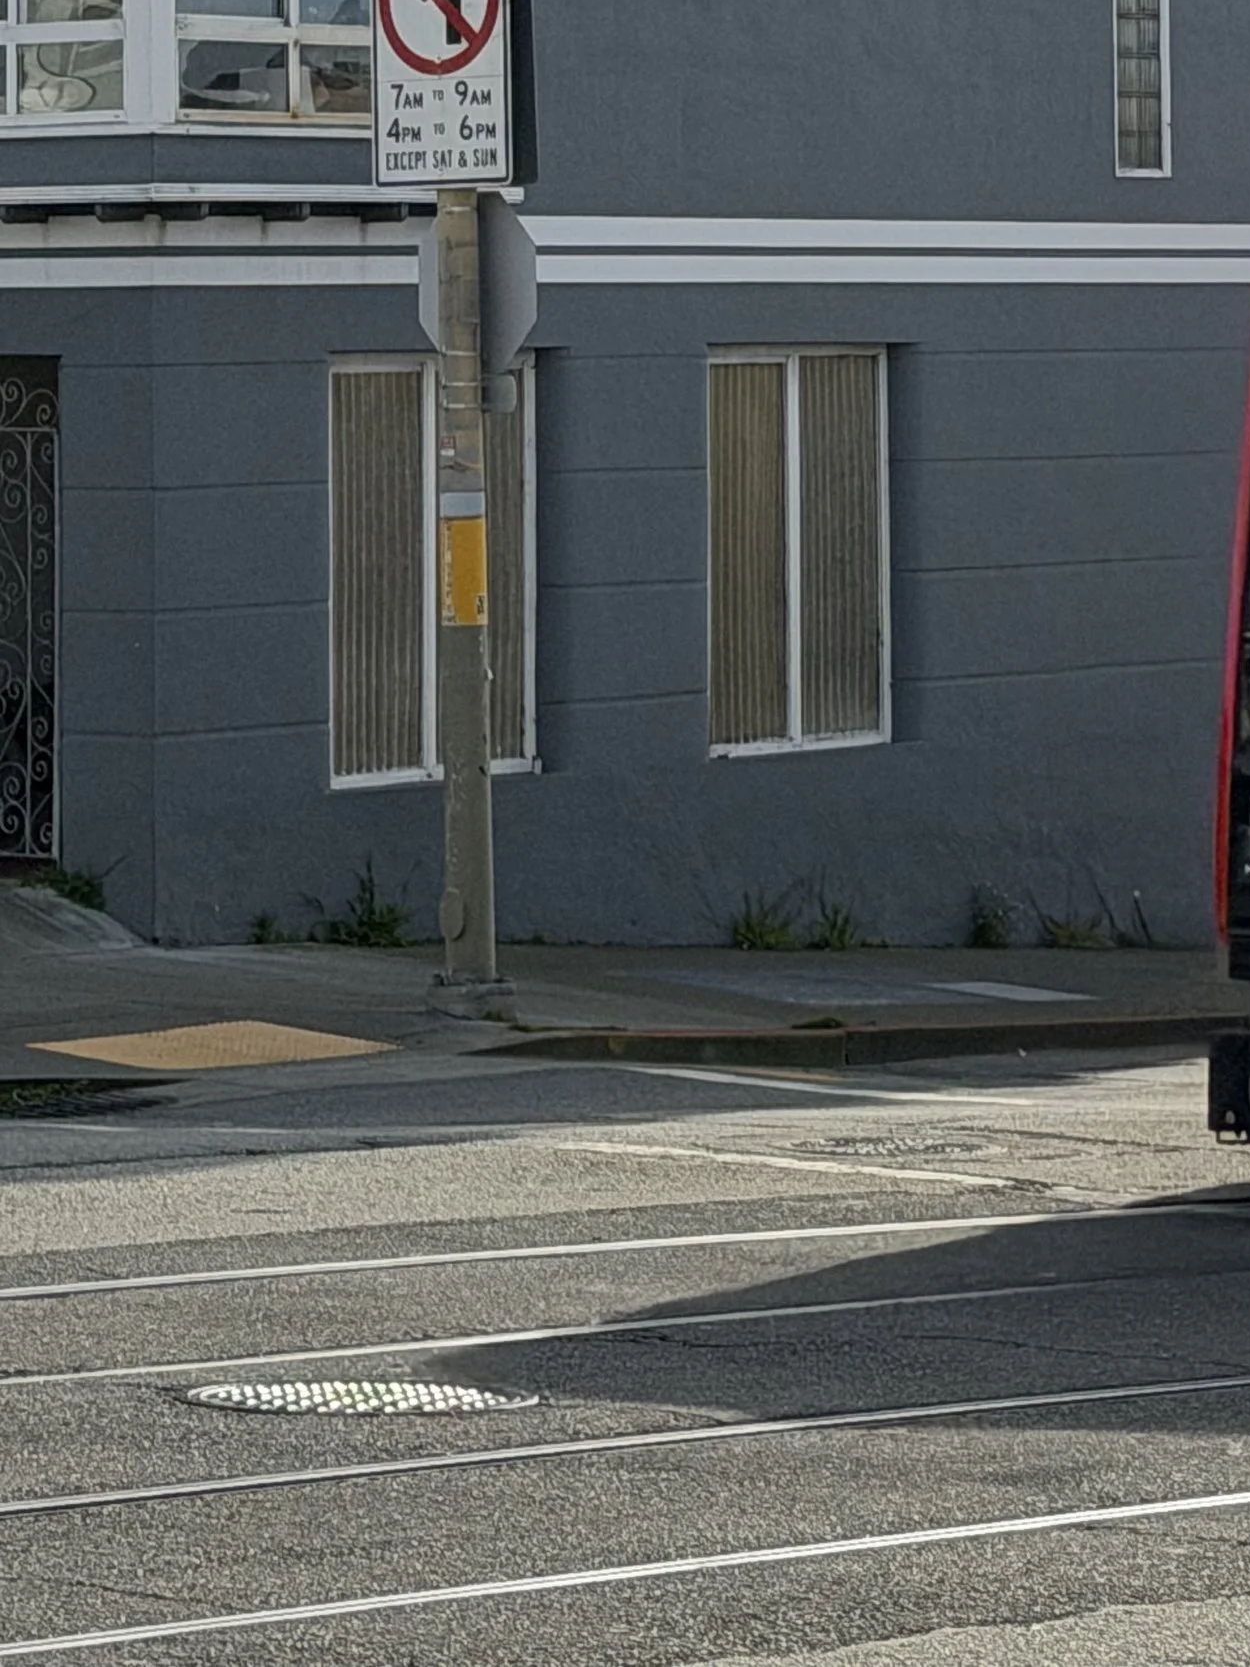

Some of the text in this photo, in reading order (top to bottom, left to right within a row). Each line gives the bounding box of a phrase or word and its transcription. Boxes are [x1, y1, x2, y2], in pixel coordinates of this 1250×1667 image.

[390, 80, 491, 110] 7AM TO 9AM
[386, 114, 497, 143] 4PM TO 6PM
[385, 147, 498, 172] EXCEPT SAT & SUN
